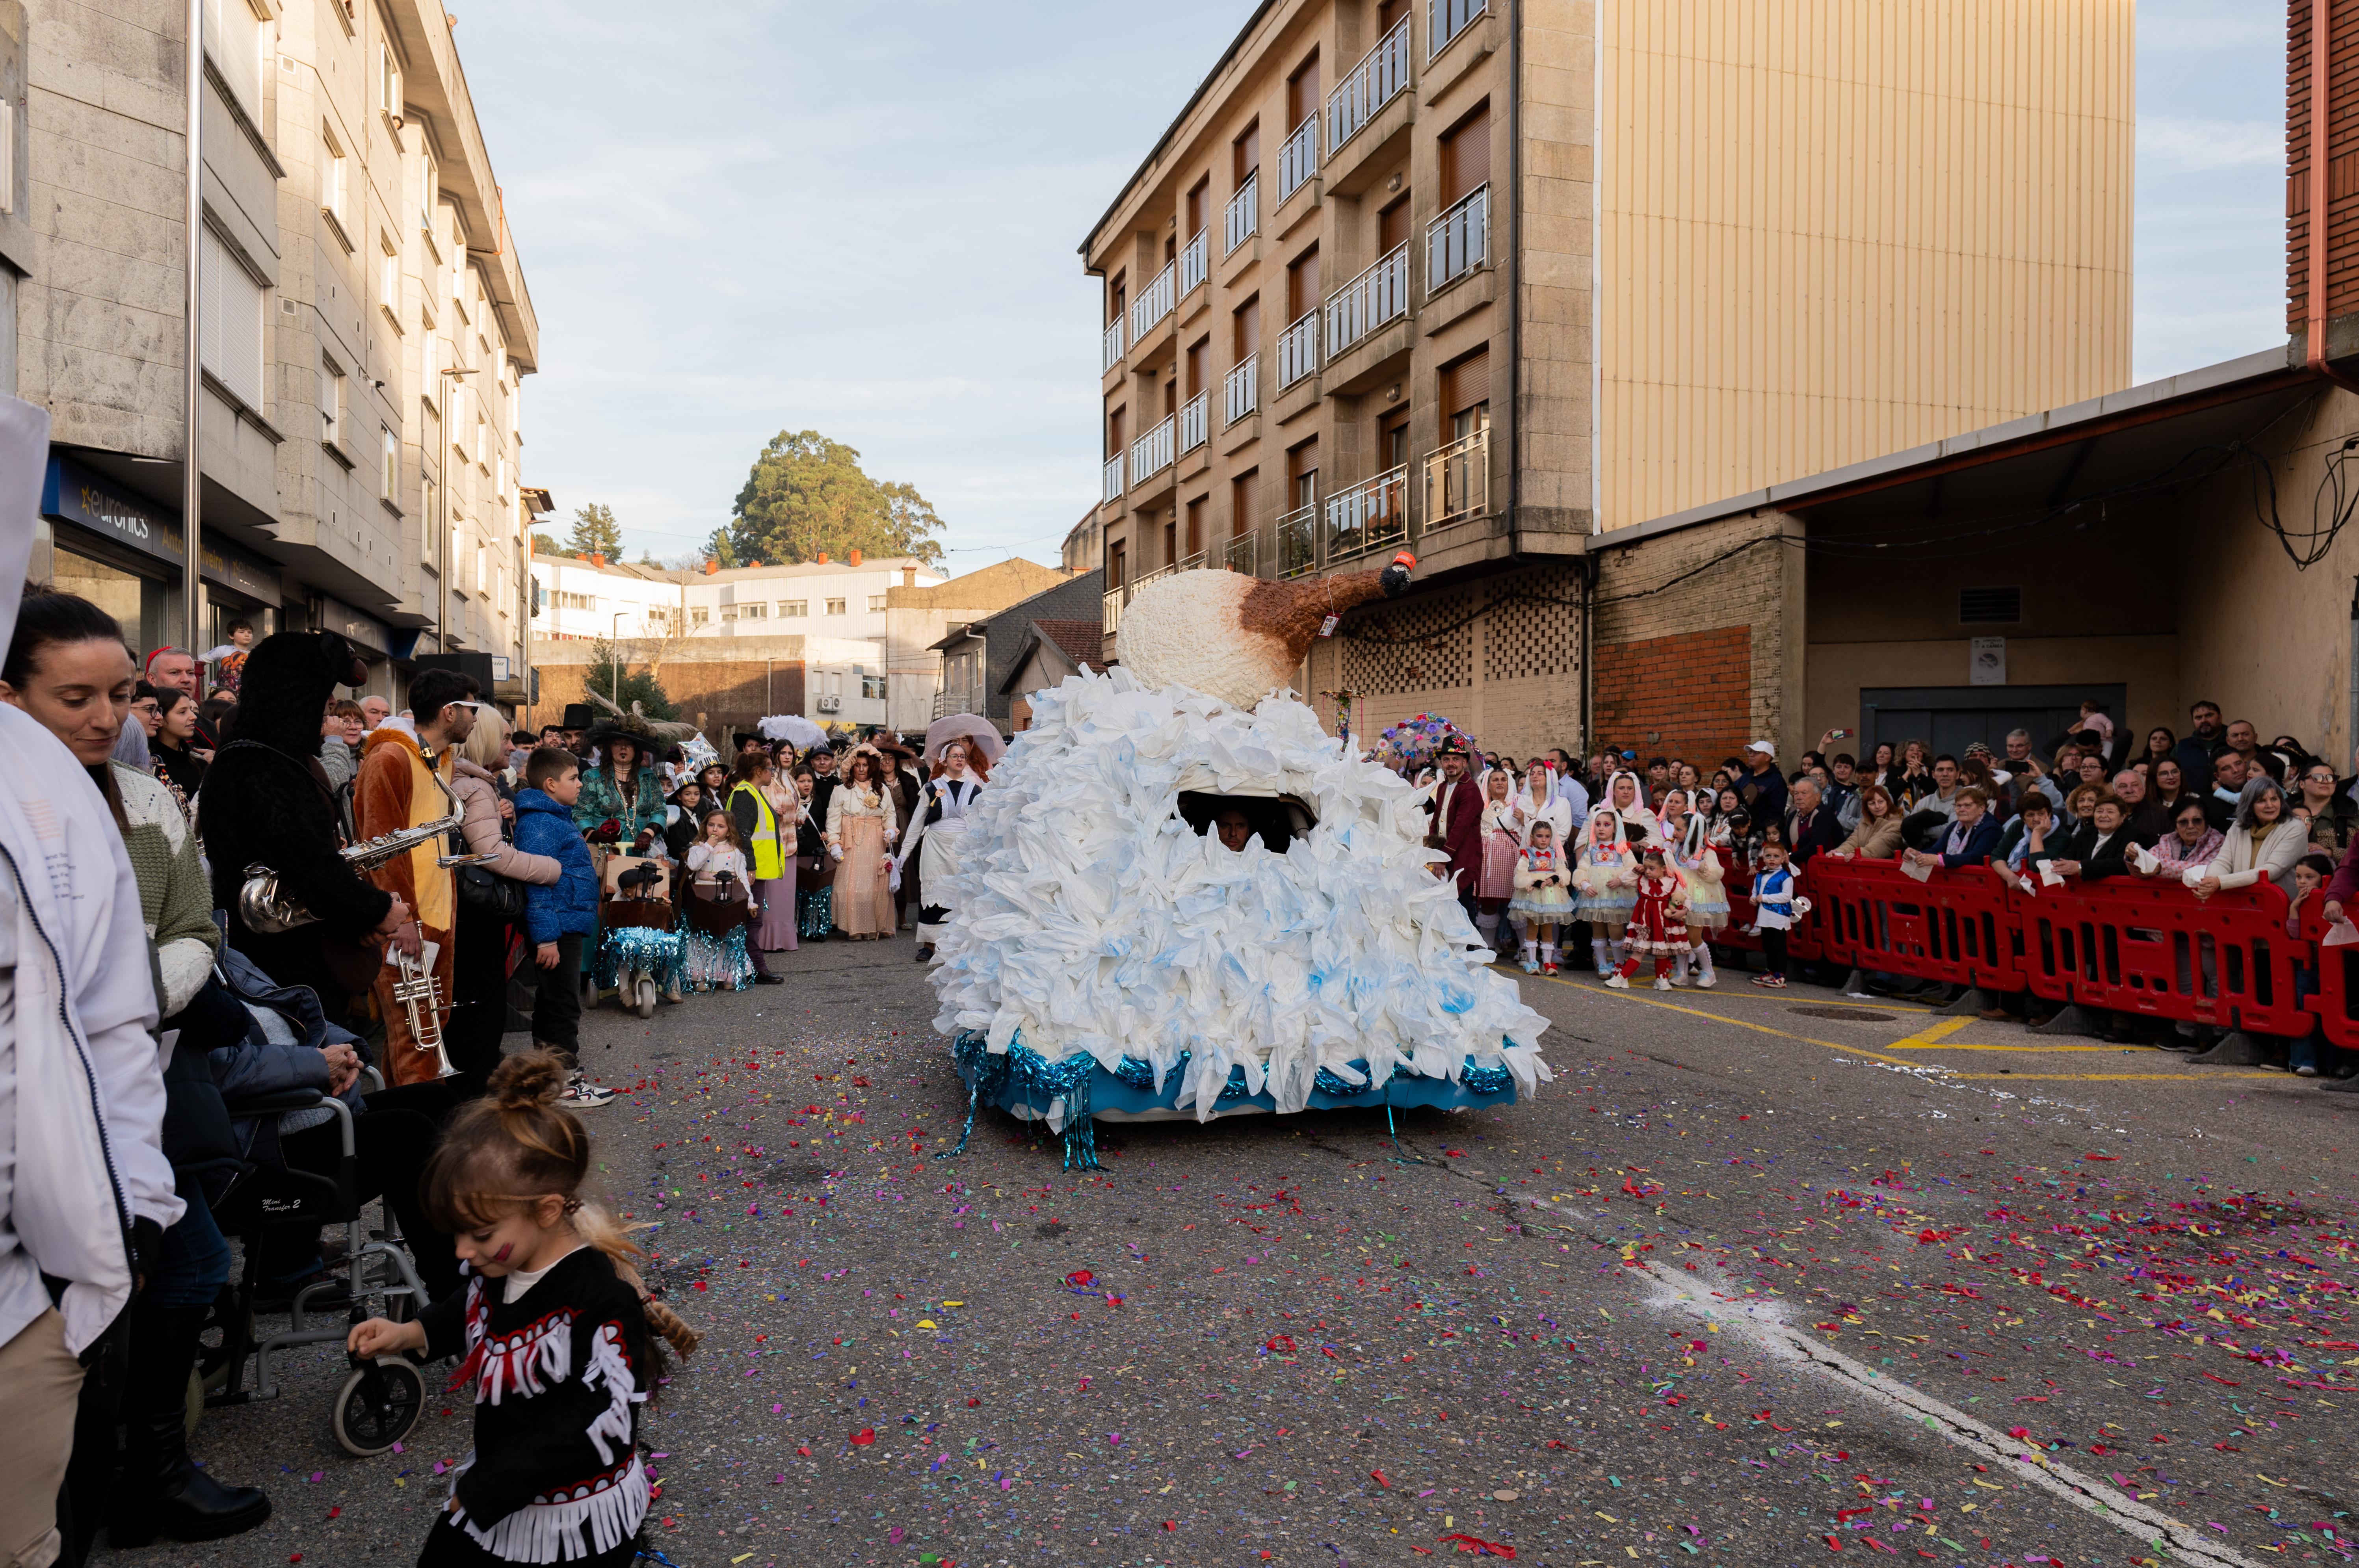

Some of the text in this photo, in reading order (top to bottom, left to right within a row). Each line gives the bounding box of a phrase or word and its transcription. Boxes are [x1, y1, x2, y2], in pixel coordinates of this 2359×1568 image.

[91, 490, 148, 539] euronics
[162, 524, 183, 555] Anto
[292, 1199, 301, 1208] 2
